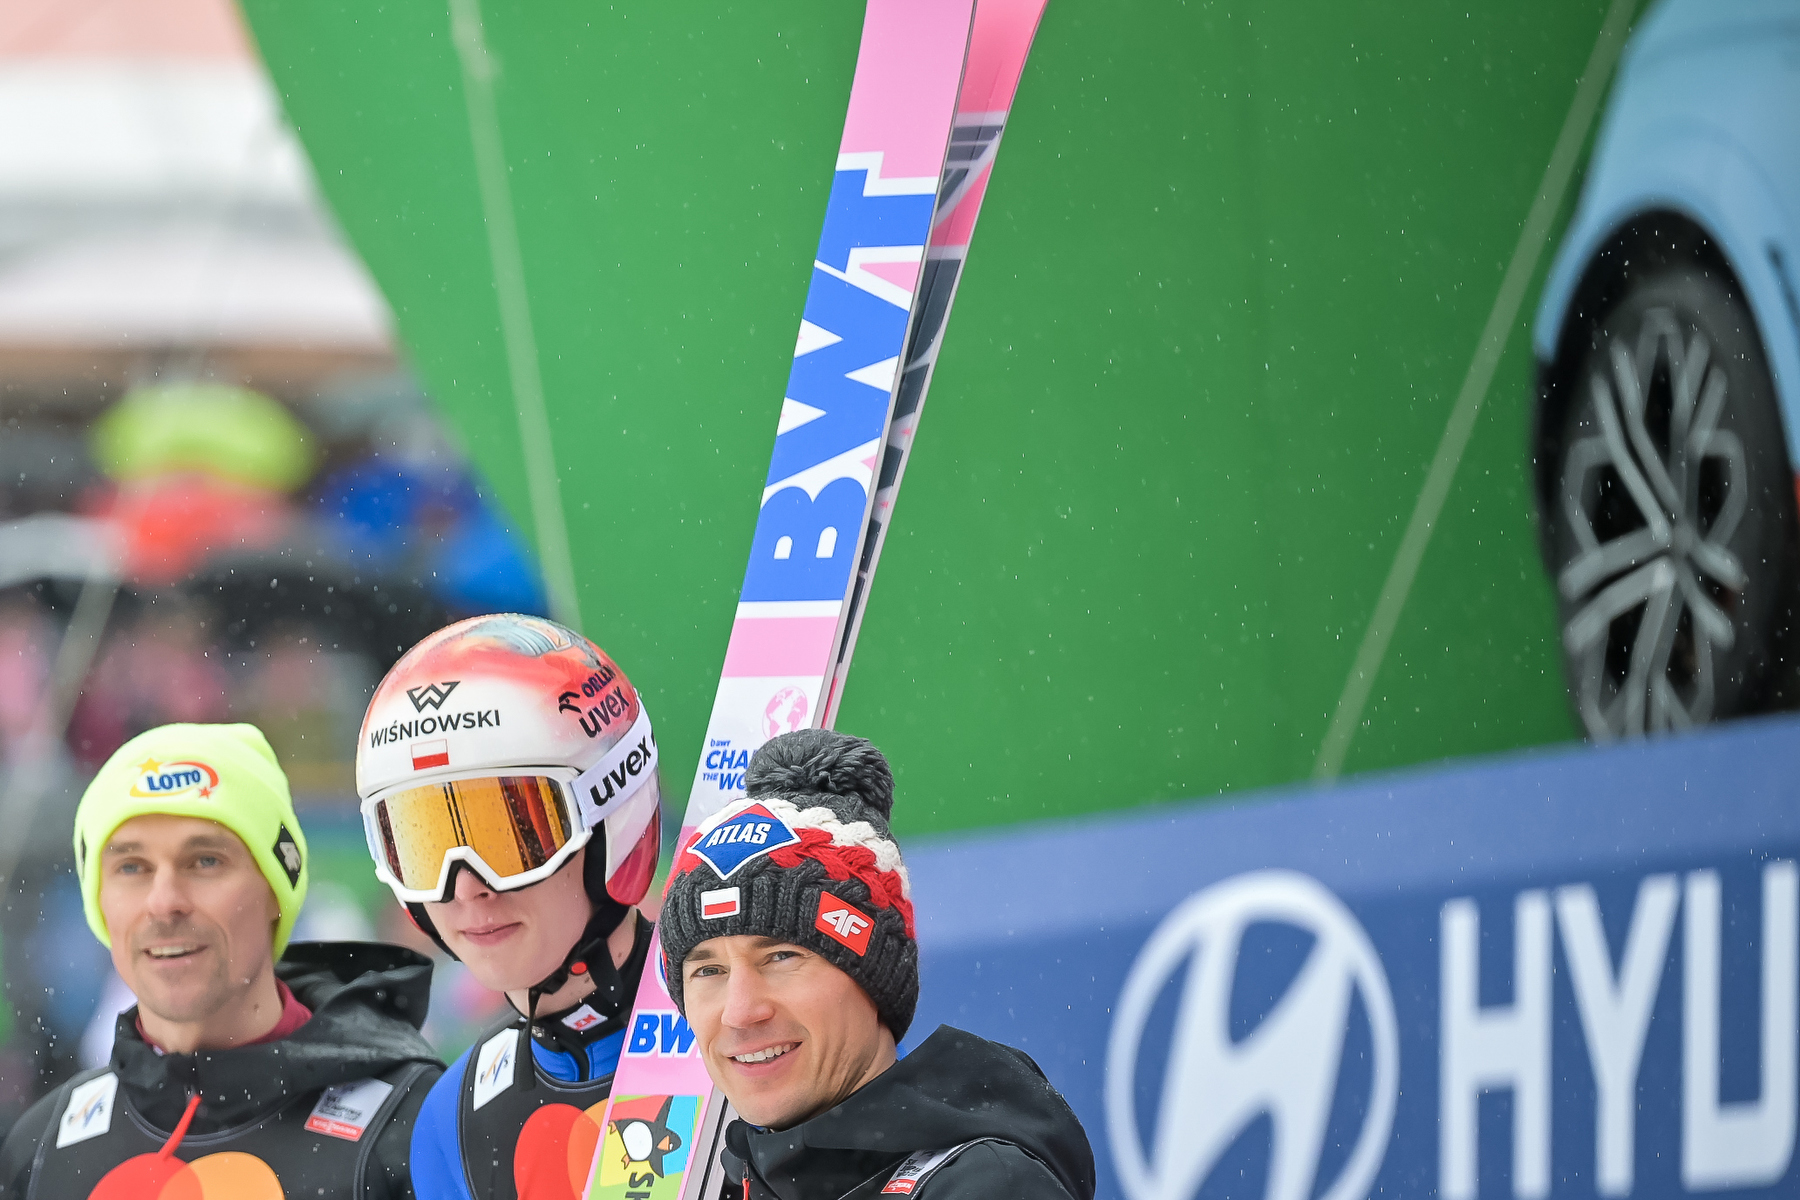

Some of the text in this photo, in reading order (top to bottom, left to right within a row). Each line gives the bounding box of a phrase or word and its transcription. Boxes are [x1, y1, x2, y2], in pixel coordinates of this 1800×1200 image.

[581, 664, 616, 698] ORLEN
[579, 686, 630, 738] uvex
[370, 710, 501, 749] WIŚNIOWSKI
[590, 736, 652, 806] uvex
[707, 749, 749, 770] CHA
[147, 770, 201, 791] LOTTO
[704, 821, 772, 849] ATLAS
[821, 908, 869, 938] 4F
[628, 1013, 697, 1055] BW
